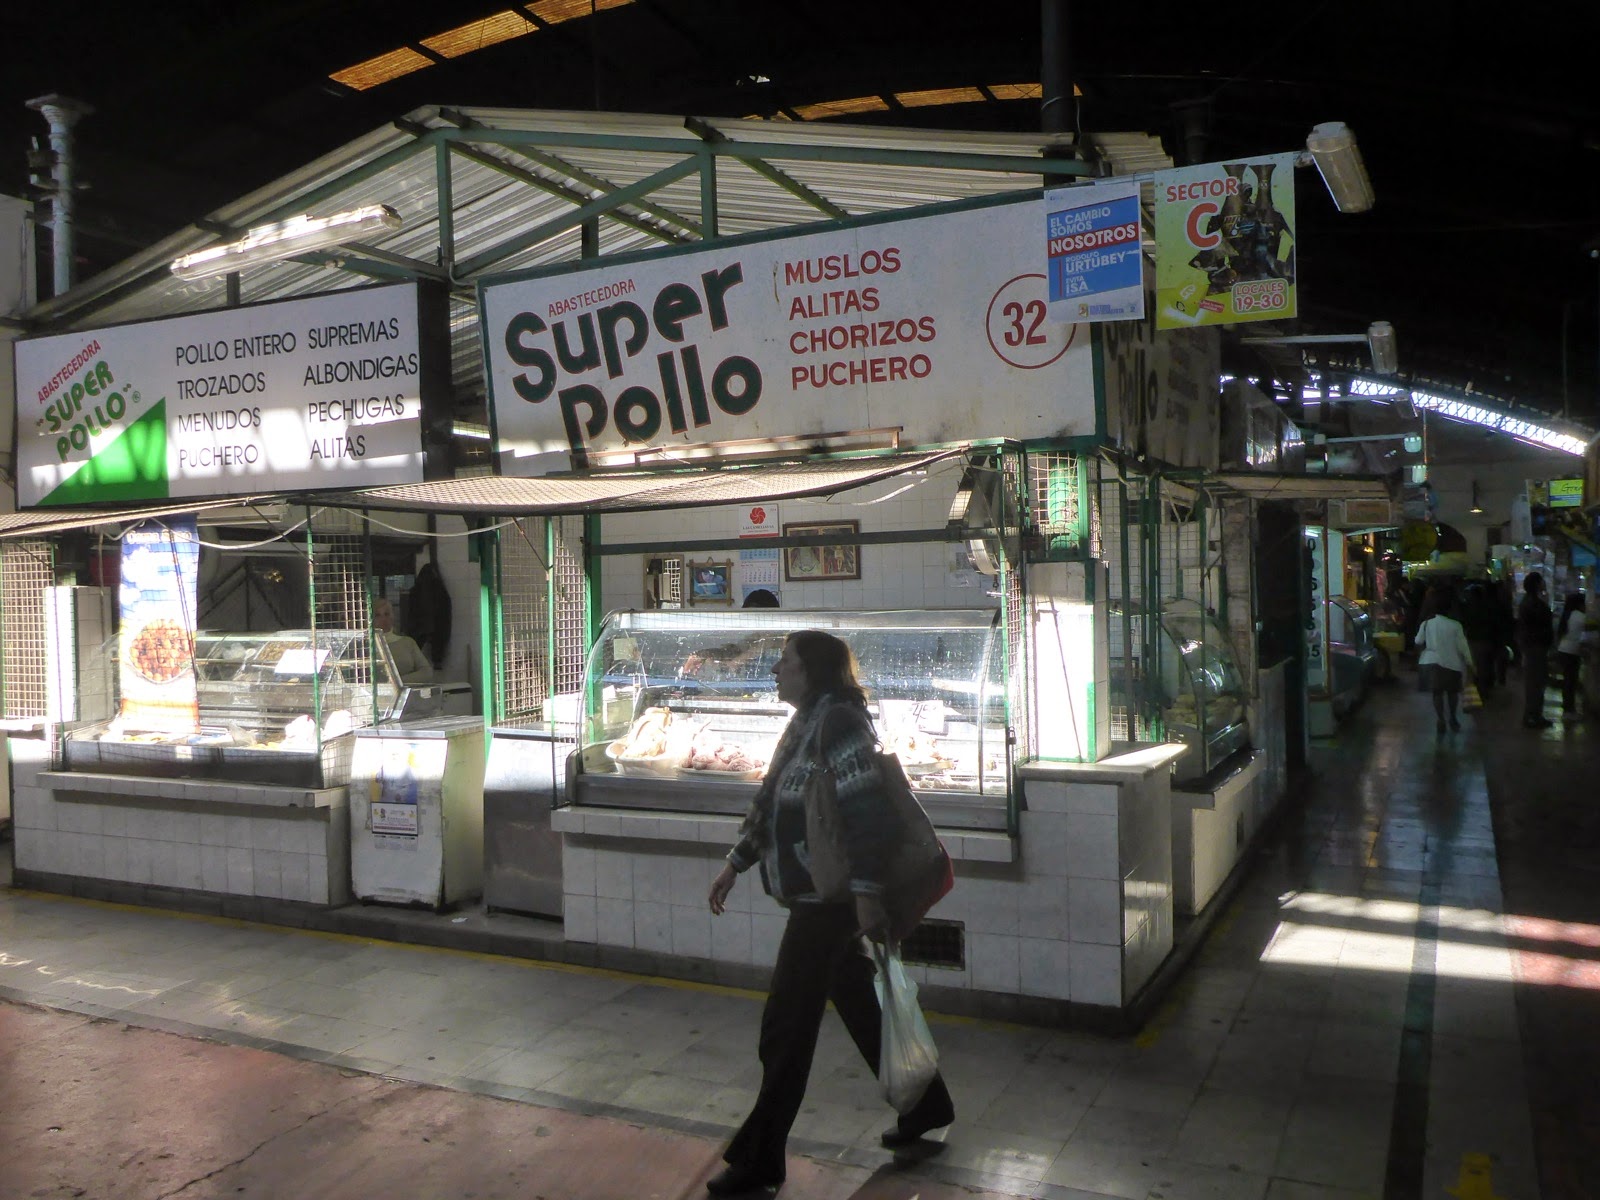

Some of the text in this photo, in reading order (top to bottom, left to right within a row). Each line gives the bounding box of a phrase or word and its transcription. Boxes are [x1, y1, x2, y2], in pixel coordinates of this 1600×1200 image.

[1166, 177, 1239, 203] SECTOR
[1050, 207, 1111, 229] EL CAMBIO
[1051, 220, 1093, 238] SOMOS
[1187, 202, 1220, 248] C
[1050, 224, 1136, 255] NOSOTROS
[784, 247, 901, 286] MUSLOS
[1066, 251, 1100, 263] RODOLFO
[1066, 251, 1126, 274] URTUBEY
[548, 278, 636, 318] ABASTECEDORA
[1066, 281, 1089, 294] ISA
[1235, 293, 1284, 312] 19-30
[1236, 282, 1285, 296] LOCALES
[788, 287, 880, 321] ALITAS
[308, 316, 400, 350] SUPREMAS
[504, 261, 744, 404] Super
[789, 316, 937, 355] CHORIZOS
[1002, 299, 1047, 347] 32
[175, 331, 297, 366] POLLO ENTERO
[37, 339, 102, 405] ABASTECEDORA
[303, 352, 418, 387] ALBONDIGAS
[791, 353, 932, 391] PUCHERO
[177, 371, 266, 400] TROZADOS
[178, 407, 262, 434] MENUDOS
[308, 394, 405, 423] PECHUGAS
[179, 444, 259, 469] PUCHERO
[309, 435, 366, 460] ALITAS
